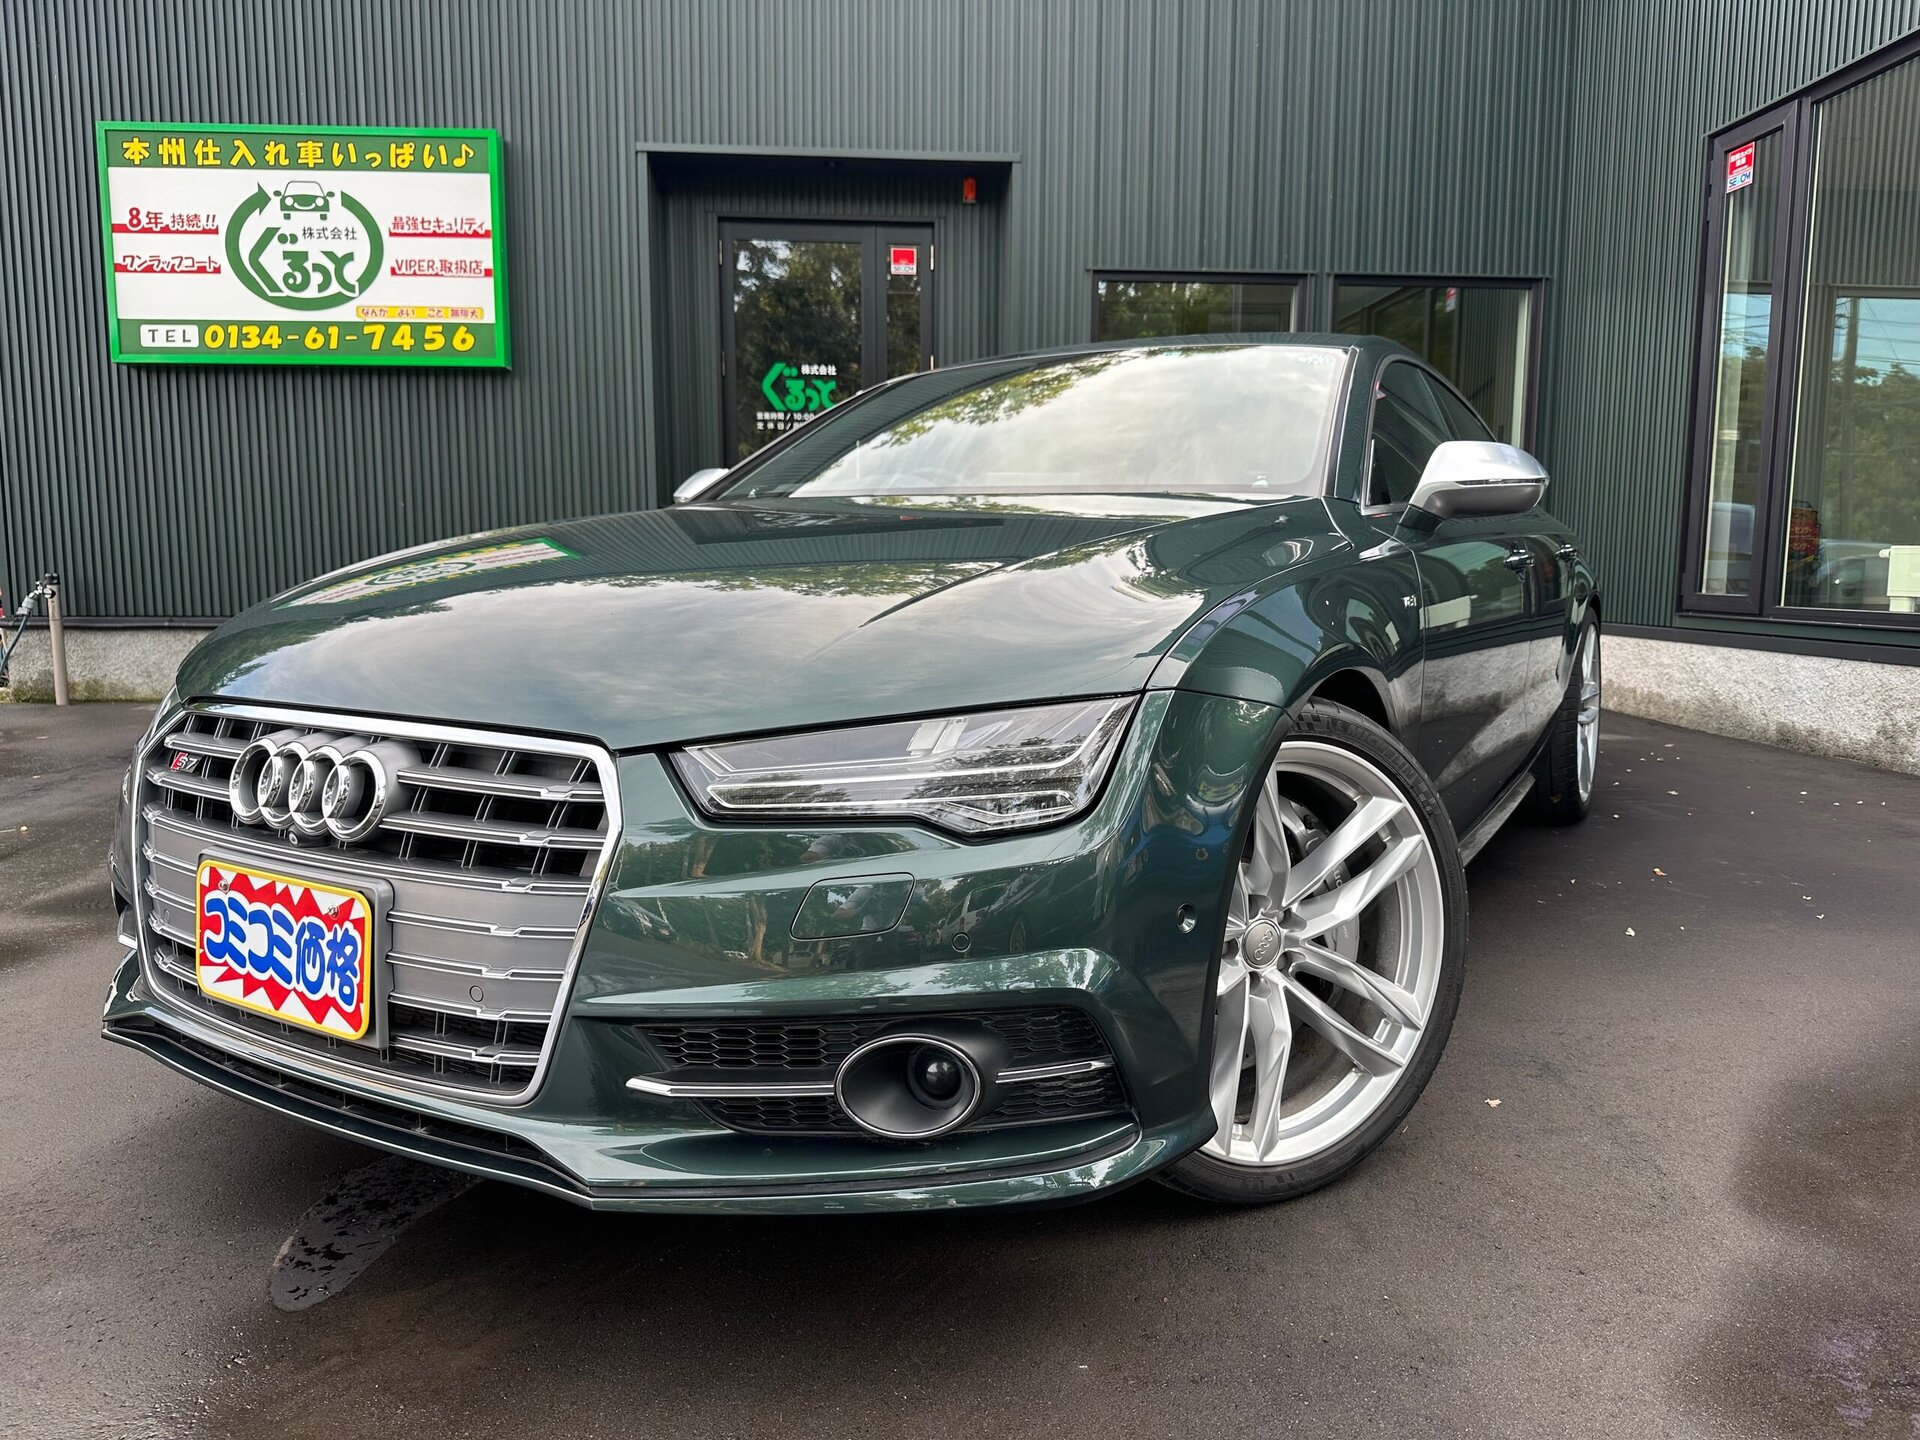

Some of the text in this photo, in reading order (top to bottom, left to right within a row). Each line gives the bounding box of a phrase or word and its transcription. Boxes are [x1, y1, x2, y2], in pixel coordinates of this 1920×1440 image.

[302, 226, 358, 241] 株式会社
[392, 216, 485, 231] 最強セキュリティ
[248, 227, 359, 295] ぐるっと
[148, 324, 475, 351] TEL 0134-61-7456
[205, 895, 358, 1007] コミコミ価格
